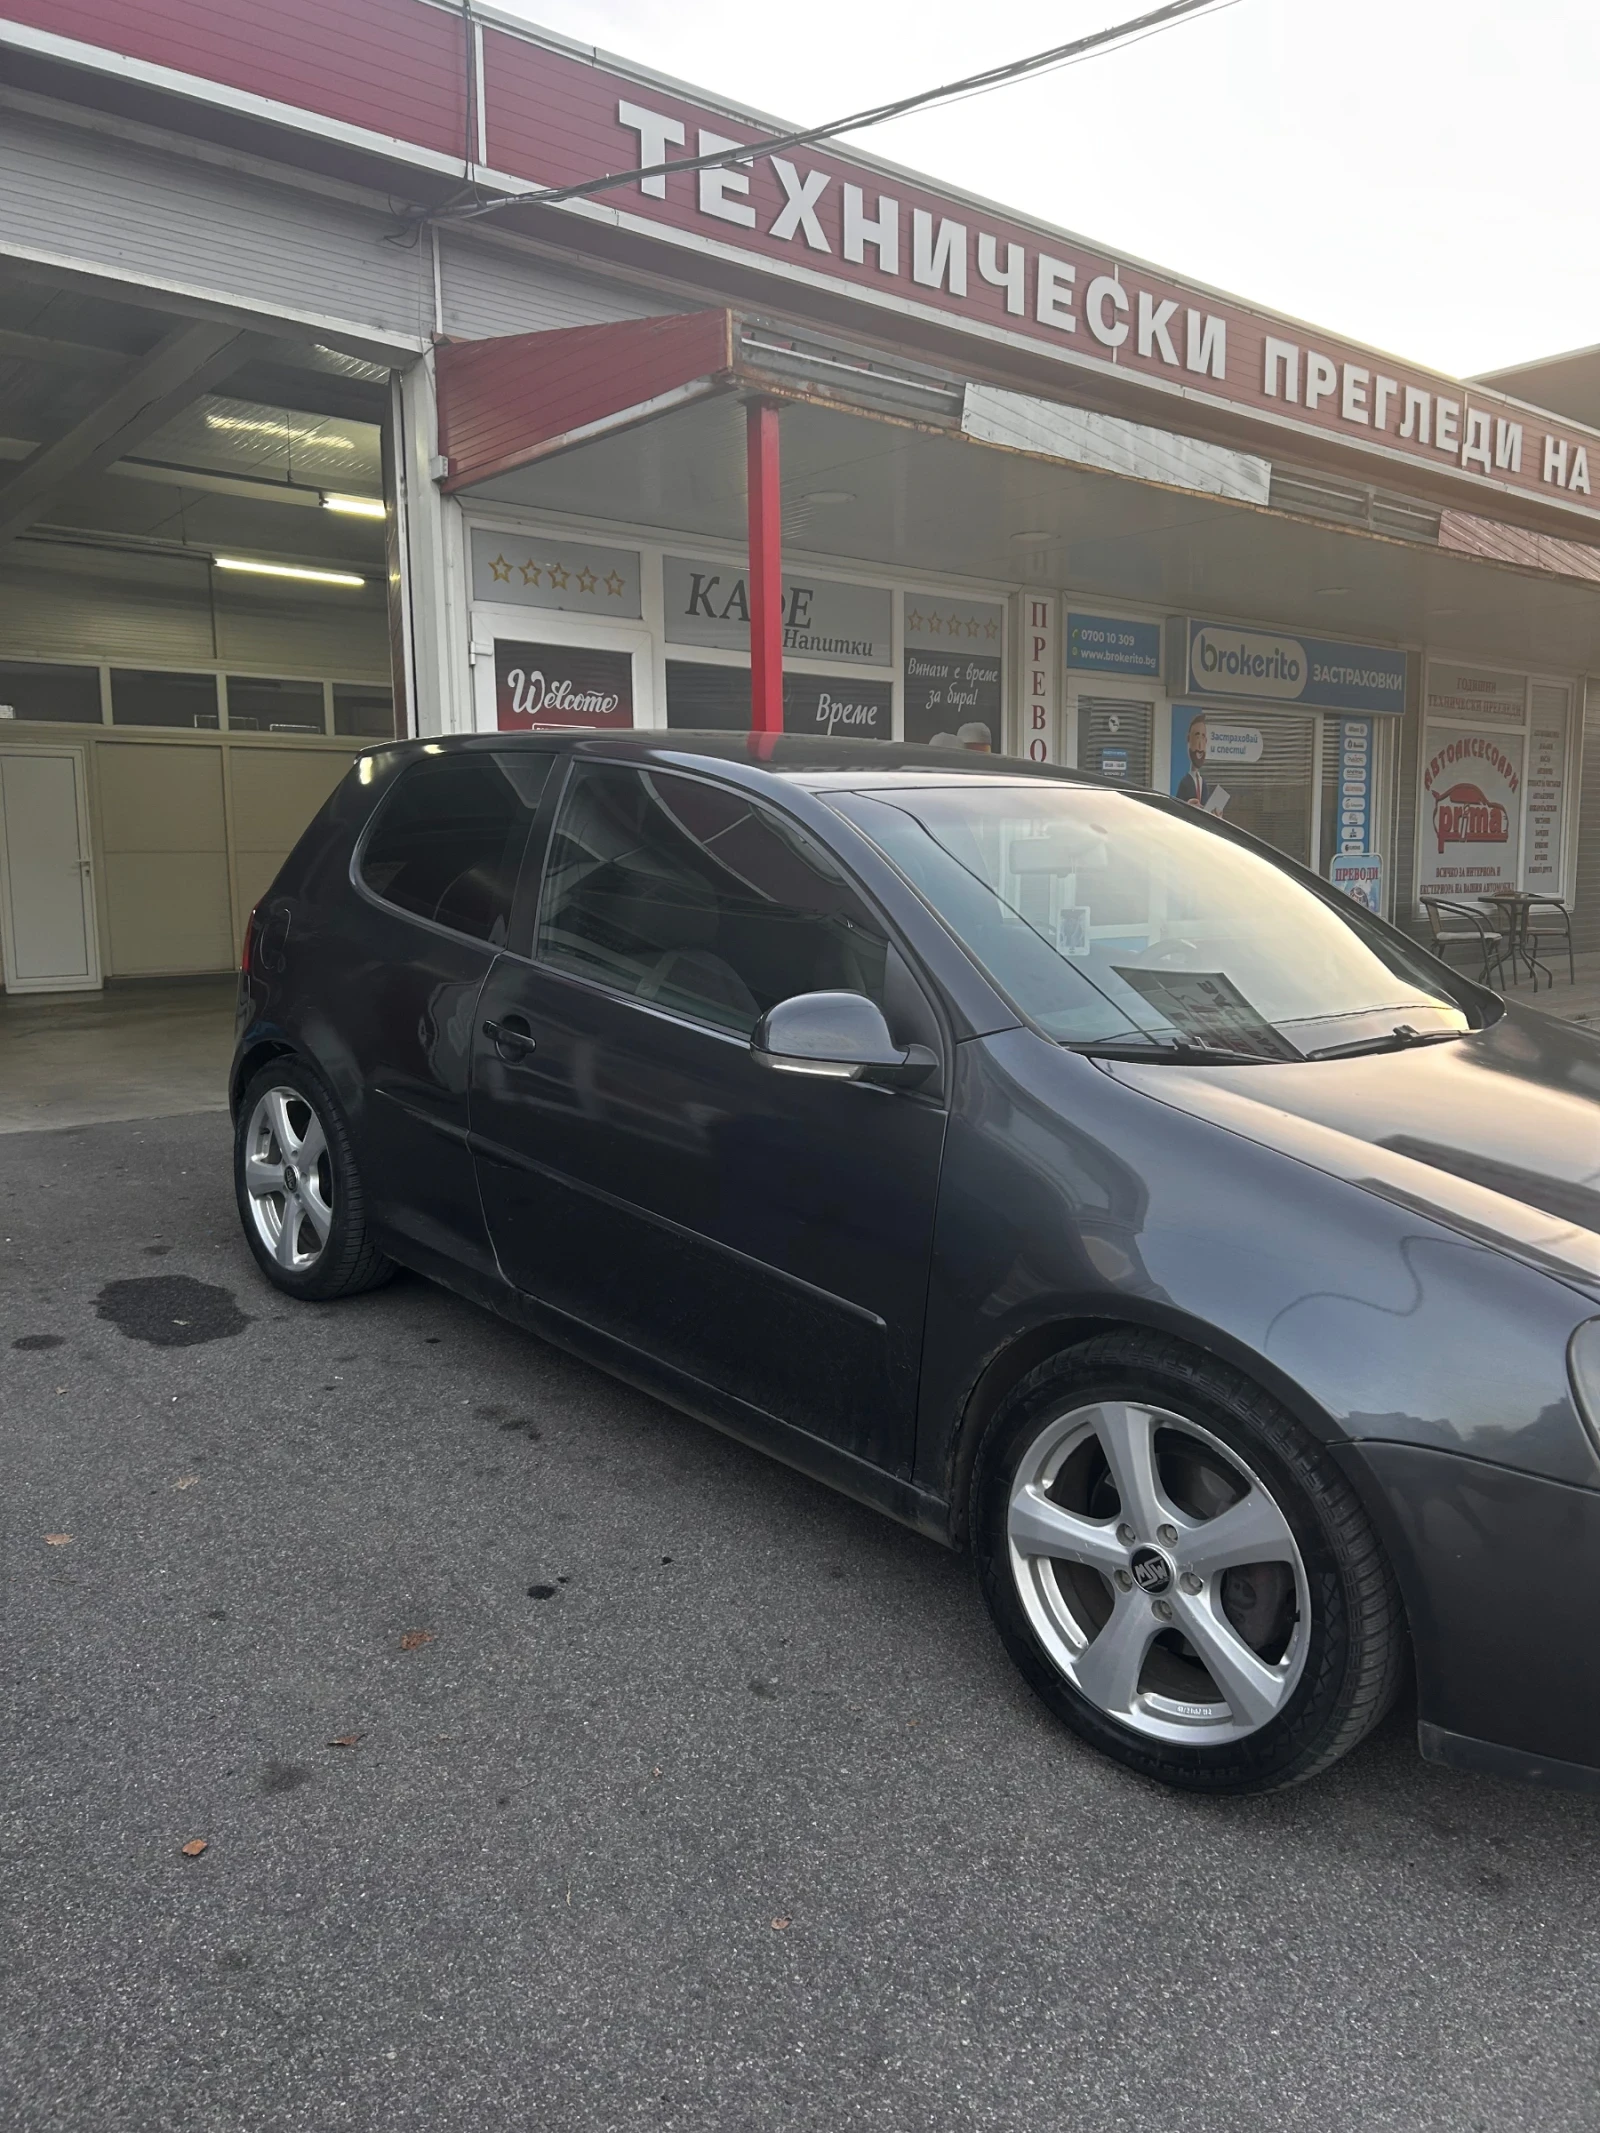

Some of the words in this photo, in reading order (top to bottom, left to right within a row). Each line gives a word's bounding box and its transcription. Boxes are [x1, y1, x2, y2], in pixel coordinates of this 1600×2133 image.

[619, 99, 1226, 380] ТЕХНИЧЕСКИ
[1264, 336, 1522, 474] ПРЕГЛЕДИ
[1544, 435, 1591, 495] НА
[685, 573, 814, 629] КАЕ
[782, 628, 874, 657] Напитки
[1081, 629, 1105, 643] 0700
[1106, 632, 1117, 644] 10
[1118, 634, 1135, 646] 309
[907, 657, 949, 678] Винаги
[954, 667, 961, 679] е
[965, 662, 999, 688] време
[1080, 649, 1157, 668] www.brokerito.bg
[1200, 633, 1300, 682] brokerito
[507, 668, 619, 714] Welcome
[1312, 663, 1404, 691] ЗАСТРАХОВКИ
[925, 689, 941, 710] за
[947, 681, 979, 712] бира!
[1428, 694, 1482, 712] ТЕХНИЧЕСКИ
[815, 693, 878, 736] Време
[1210, 731, 1258, 743] Застраховай
[1210, 745, 1216, 753] и
[1217, 745, 1247, 755] спести!
[1424, 738, 1519, 794] АВТОАКСЕСОАРИ
[1335, 867, 1379, 883] ПРЕВОДИ
[1134, 1555, 1168, 1587] MSW
